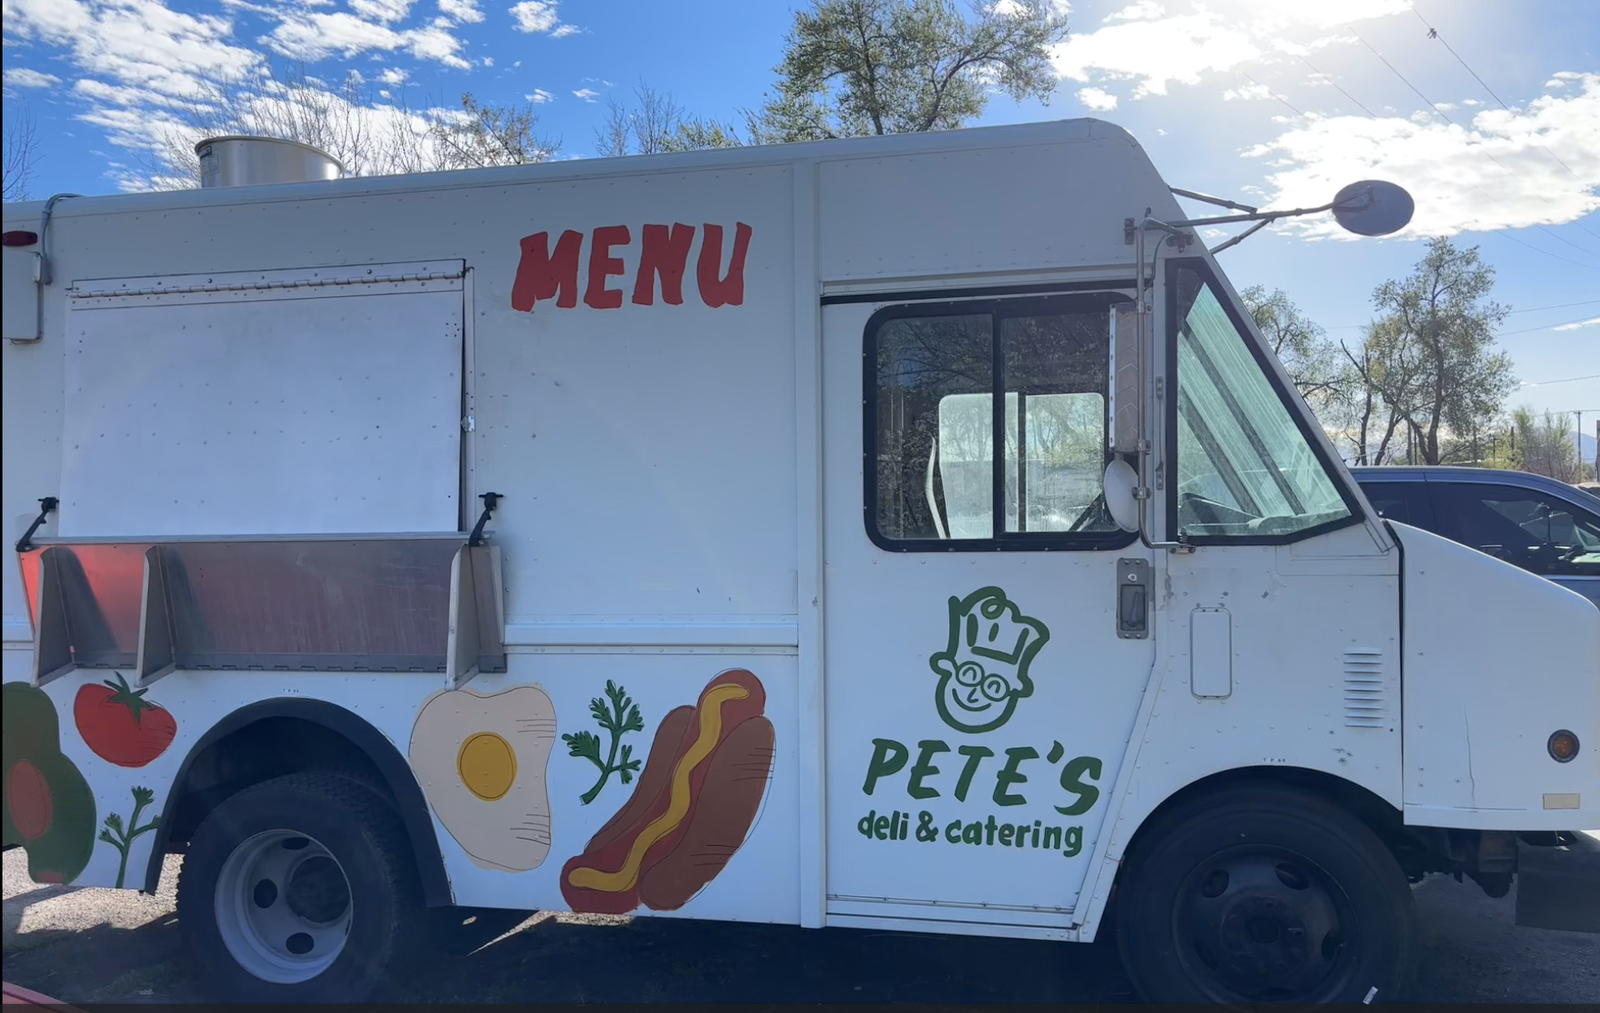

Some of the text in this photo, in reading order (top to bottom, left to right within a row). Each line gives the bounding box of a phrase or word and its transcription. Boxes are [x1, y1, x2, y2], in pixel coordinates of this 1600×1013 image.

[511, 221, 753, 312] MENU
[862, 738, 1103, 816] PETE'S
[857, 810, 1083, 857] deli & catering
